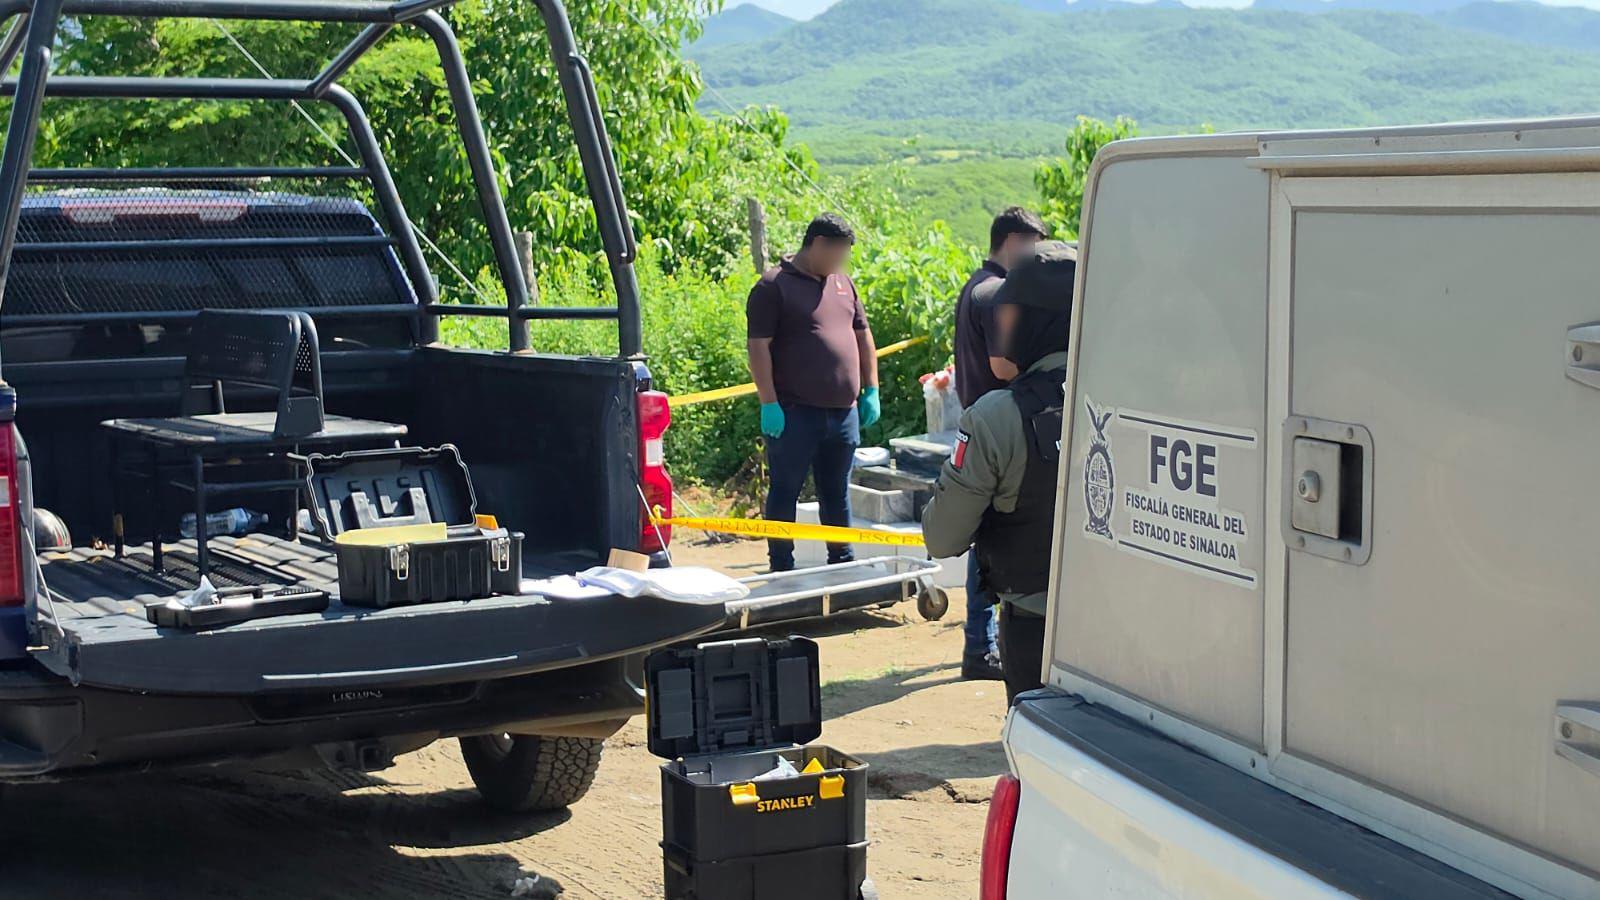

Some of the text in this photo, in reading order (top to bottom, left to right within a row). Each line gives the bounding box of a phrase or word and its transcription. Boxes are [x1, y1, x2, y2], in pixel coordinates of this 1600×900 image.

[1151, 435, 1216, 497] FGE
[704, 519, 791, 536] CRIMEN
[1126, 492, 1245, 535] FISCALÍA GENERAL DEL
[1133, 519, 1236, 560] ESTADO DE SINALOA
[757, 795, 814, 812] STANLEY
